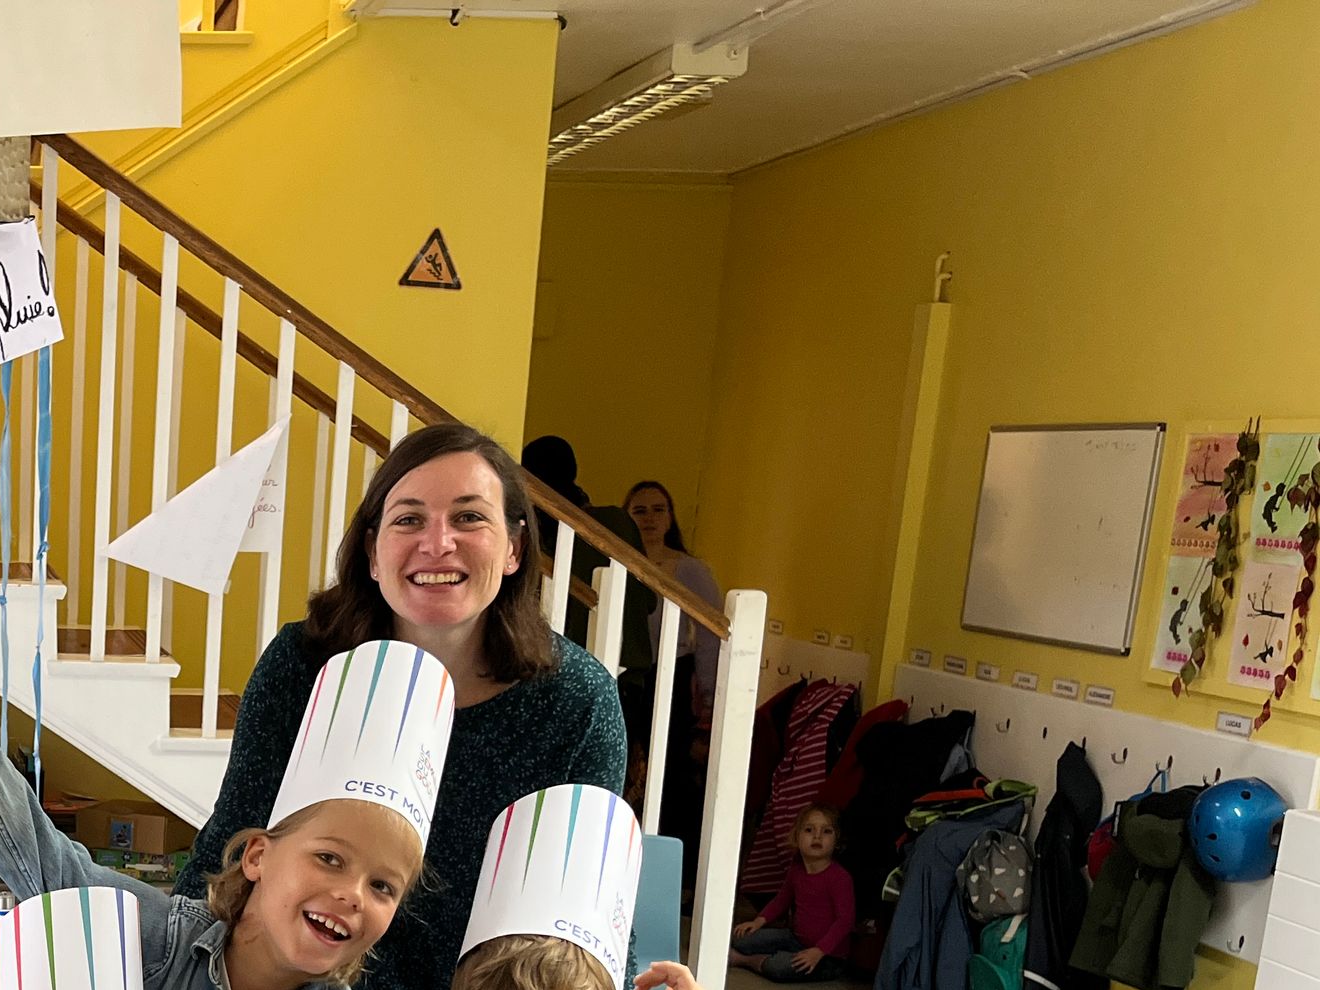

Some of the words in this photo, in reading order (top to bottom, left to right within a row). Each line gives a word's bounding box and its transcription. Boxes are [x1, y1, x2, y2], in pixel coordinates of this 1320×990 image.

[1225, 720, 1242, 728] LUCAS
[345, 780, 399, 801] C'EST
[403, 797, 424, 828] MOI
[554, 919, 601, 949] C'EST
